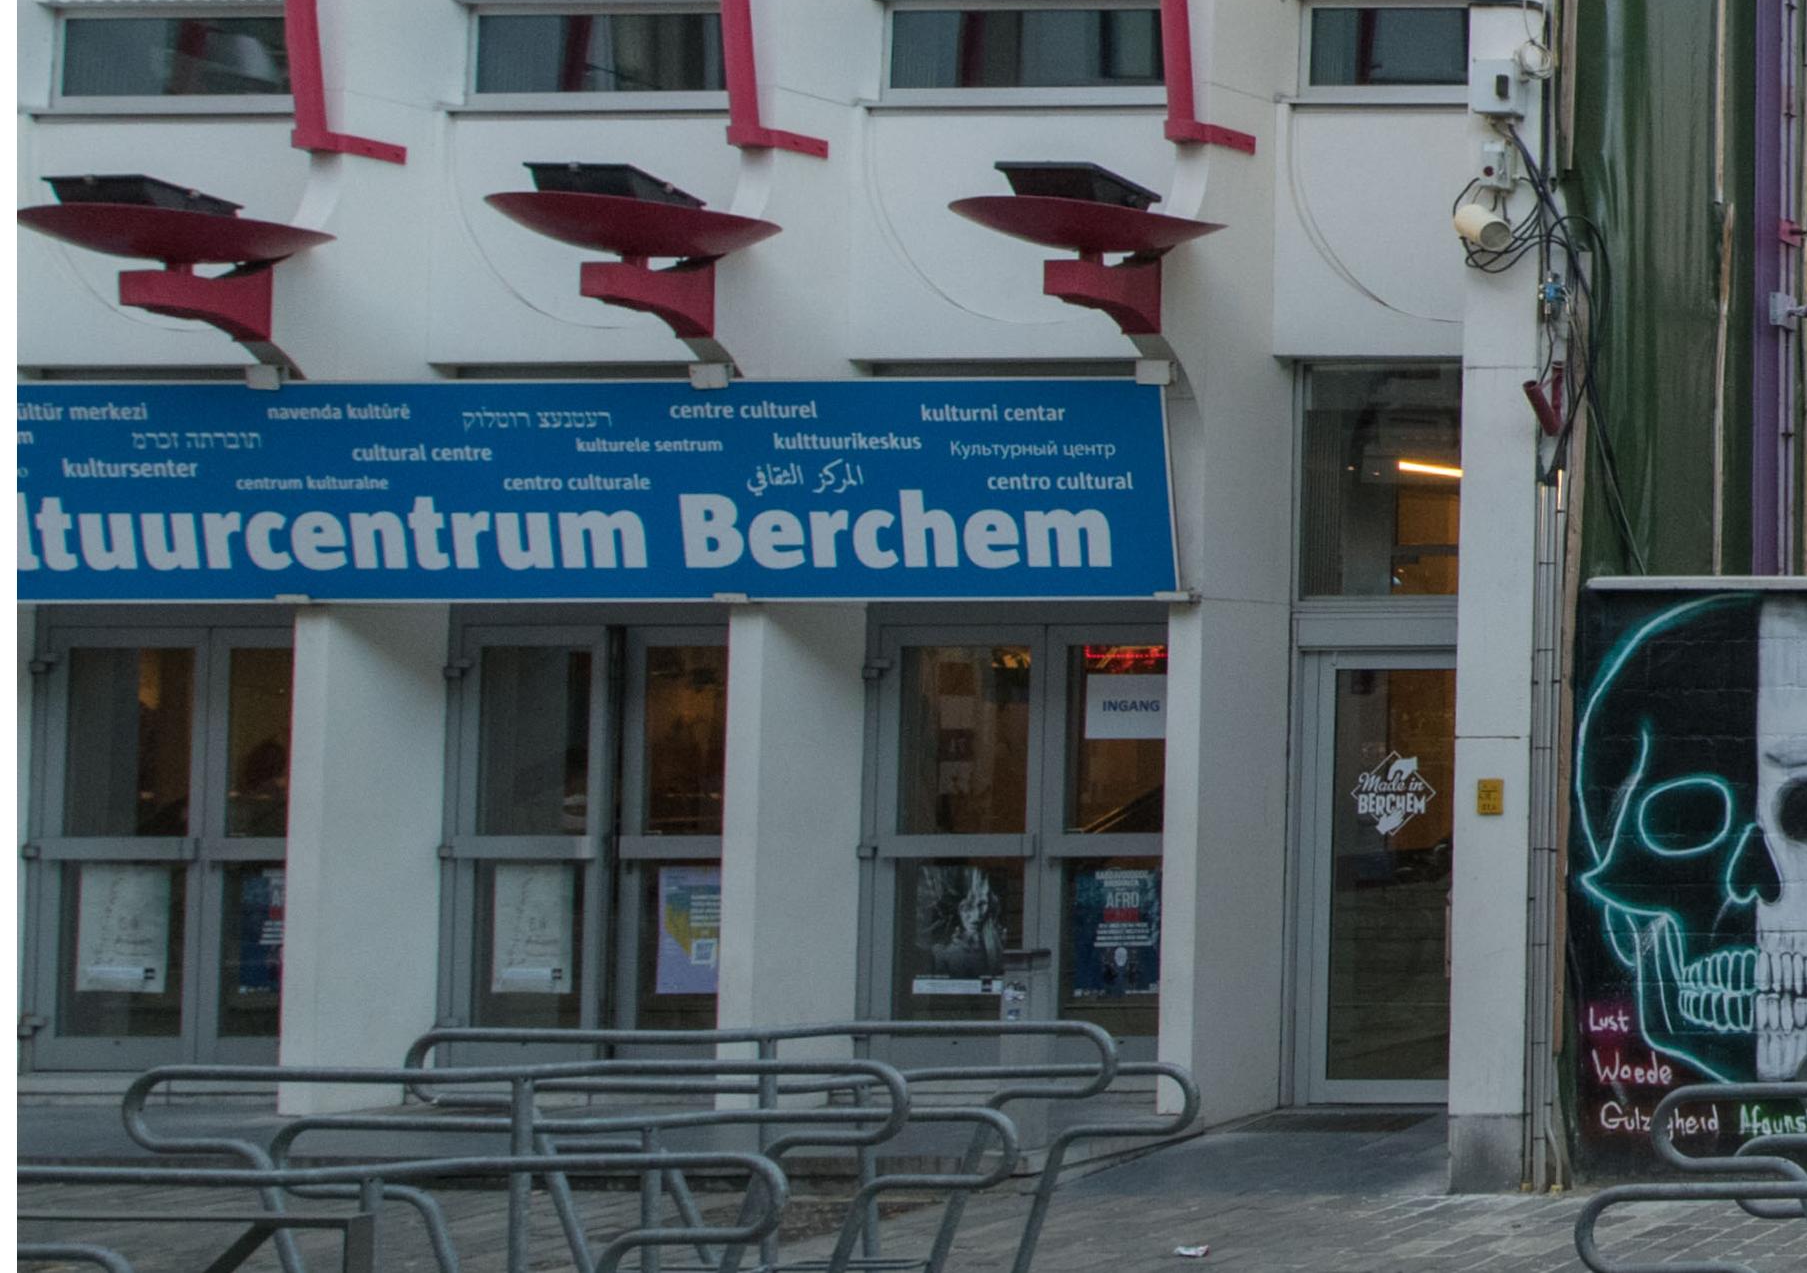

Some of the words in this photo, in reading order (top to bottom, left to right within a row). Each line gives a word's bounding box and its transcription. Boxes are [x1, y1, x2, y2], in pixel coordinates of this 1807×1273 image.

[69, 403, 147, 420] merkezi
[267, 404, 342, 419] navenda
[670, 403, 733, 418] centre
[740, 401, 817, 418] culturel
[921, 405, 997, 421] kulturni
[1004, 406, 1064, 421] centar
[576, 438, 649, 452] kulturele
[654, 440, 722, 451] sentrum
[774, 433, 921, 449] kulttuurikeskus
[352, 444, 426, 461] cultural
[431, 446, 492, 461] centre
[950, 441, 1057, 459] Культурный
[1063, 444, 1115, 459] центр
[62, 458, 197, 477] kultursenter
[236, 478, 302, 490] centrum
[307, 476, 388, 489] kulturalne
[504, 476, 562, 490] centro
[568, 474, 650, 490] culturale
[988, 474, 1050, 489] centro
[1057, 472, 1133, 489] cultural
[679, 488, 1111, 569] Berchem
[1101, 699, 1161, 713] INGANG
[1358, 771, 1406, 793] Made
[1408, 778, 1426, 793] in
[1357, 792, 1426, 817] BERCHEM
[1105, 891, 1140, 908] AFRO
[1589, 1006, 1630, 1033] Lust
[1591, 1048, 1673, 1086] Woede
